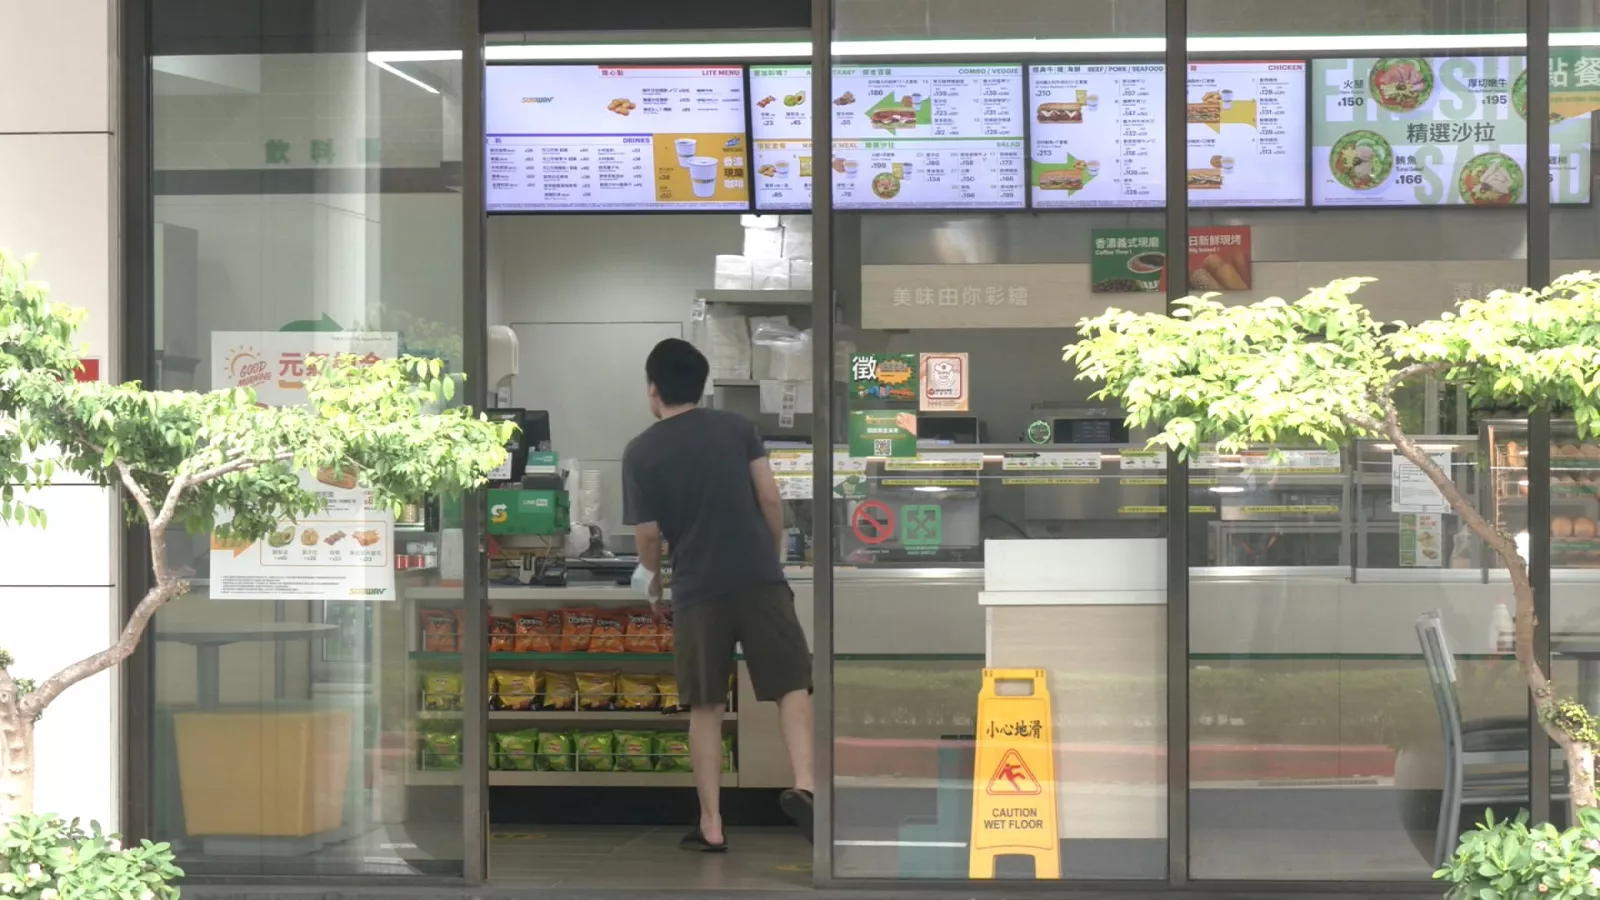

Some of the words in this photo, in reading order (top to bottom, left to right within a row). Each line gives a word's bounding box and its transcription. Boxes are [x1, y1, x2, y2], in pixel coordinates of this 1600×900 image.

[702, 69, 717, 77] LITE
[719, 69, 741, 77] MENU
[1343, 79, 1364, 90] 火腿
[1468, 78, 1507, 88] 厚切嫩牛
[521, 96, 555, 104] SUBWAY
[1338, 96, 1364, 107] $150
[1481, 95, 1508, 105] $195
[1406, 121, 1496, 144] 精選沙拉
[1395, 174, 1423, 185] $166
[1189, 234, 1241, 246] 日新鮮現烤
[892, 284, 1028, 308] 美味由你彩繪
[240, 361, 267, 379] GOOD
[852, 355, 878, 381] 徵
[237, 372, 272, 388] MORNING
[348, 587, 387, 596] SUBWAY
[986, 719, 1043, 739] 小心地滑
[992, 808, 1038, 818] CAUTION
[983, 820, 1006, 830] WET
[1008, 819, 1044, 830] FLOOR
